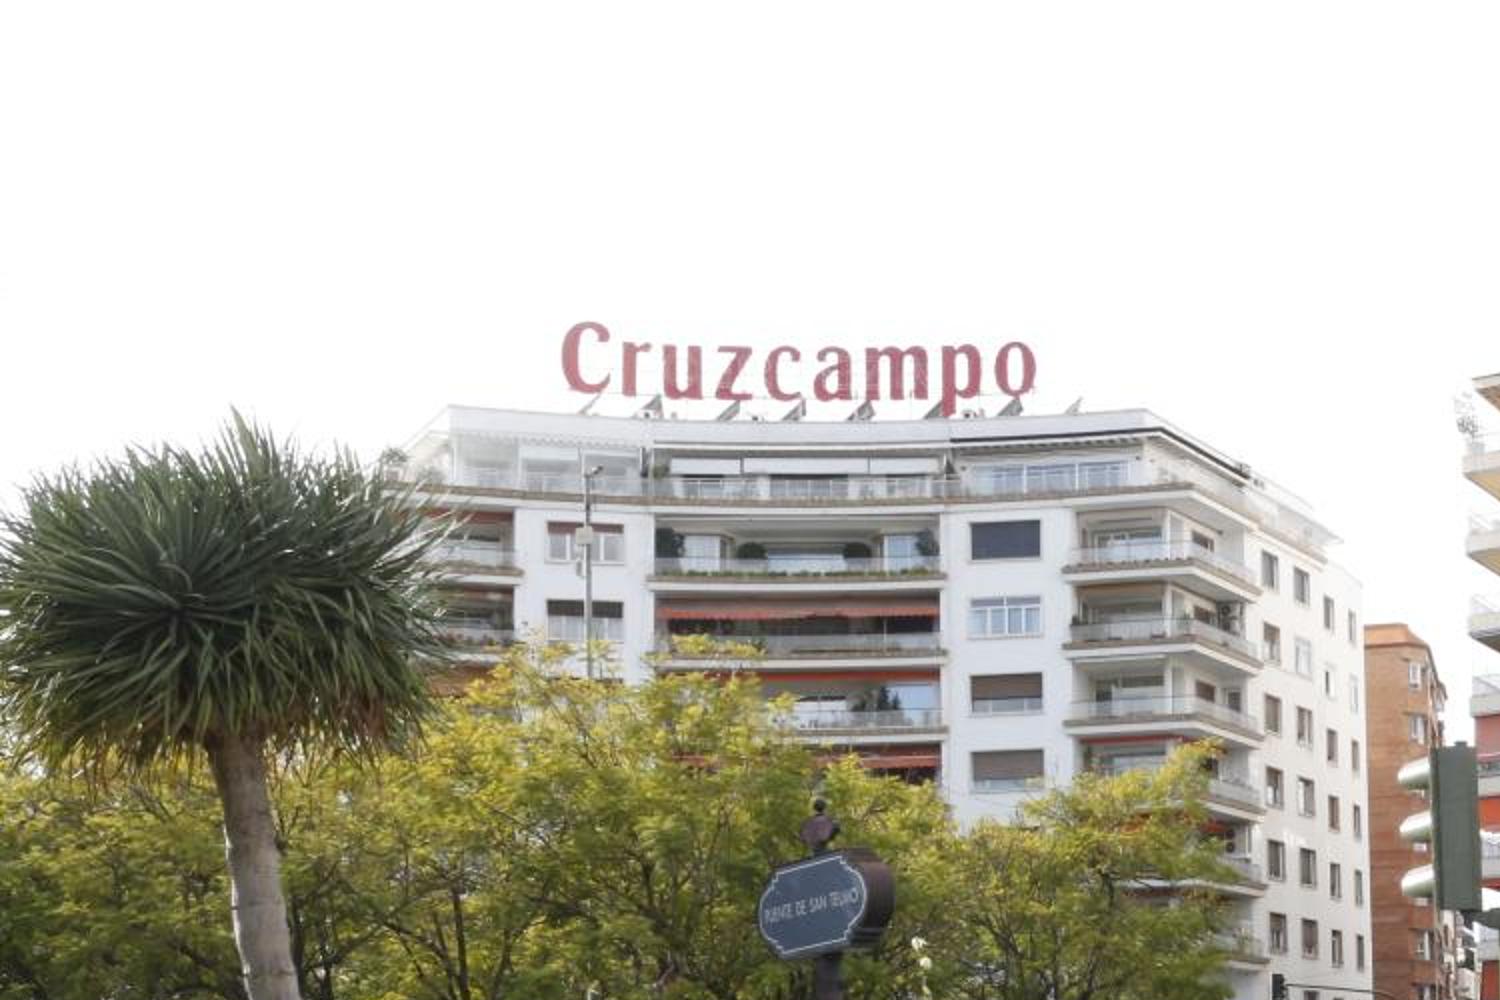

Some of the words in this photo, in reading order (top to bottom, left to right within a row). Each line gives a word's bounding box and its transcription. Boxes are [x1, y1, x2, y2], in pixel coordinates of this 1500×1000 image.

[561, 321, 1038, 416] Cruzcampo
[795, 899, 807, 916] DE
[808, 895, 828, 913] SAN
